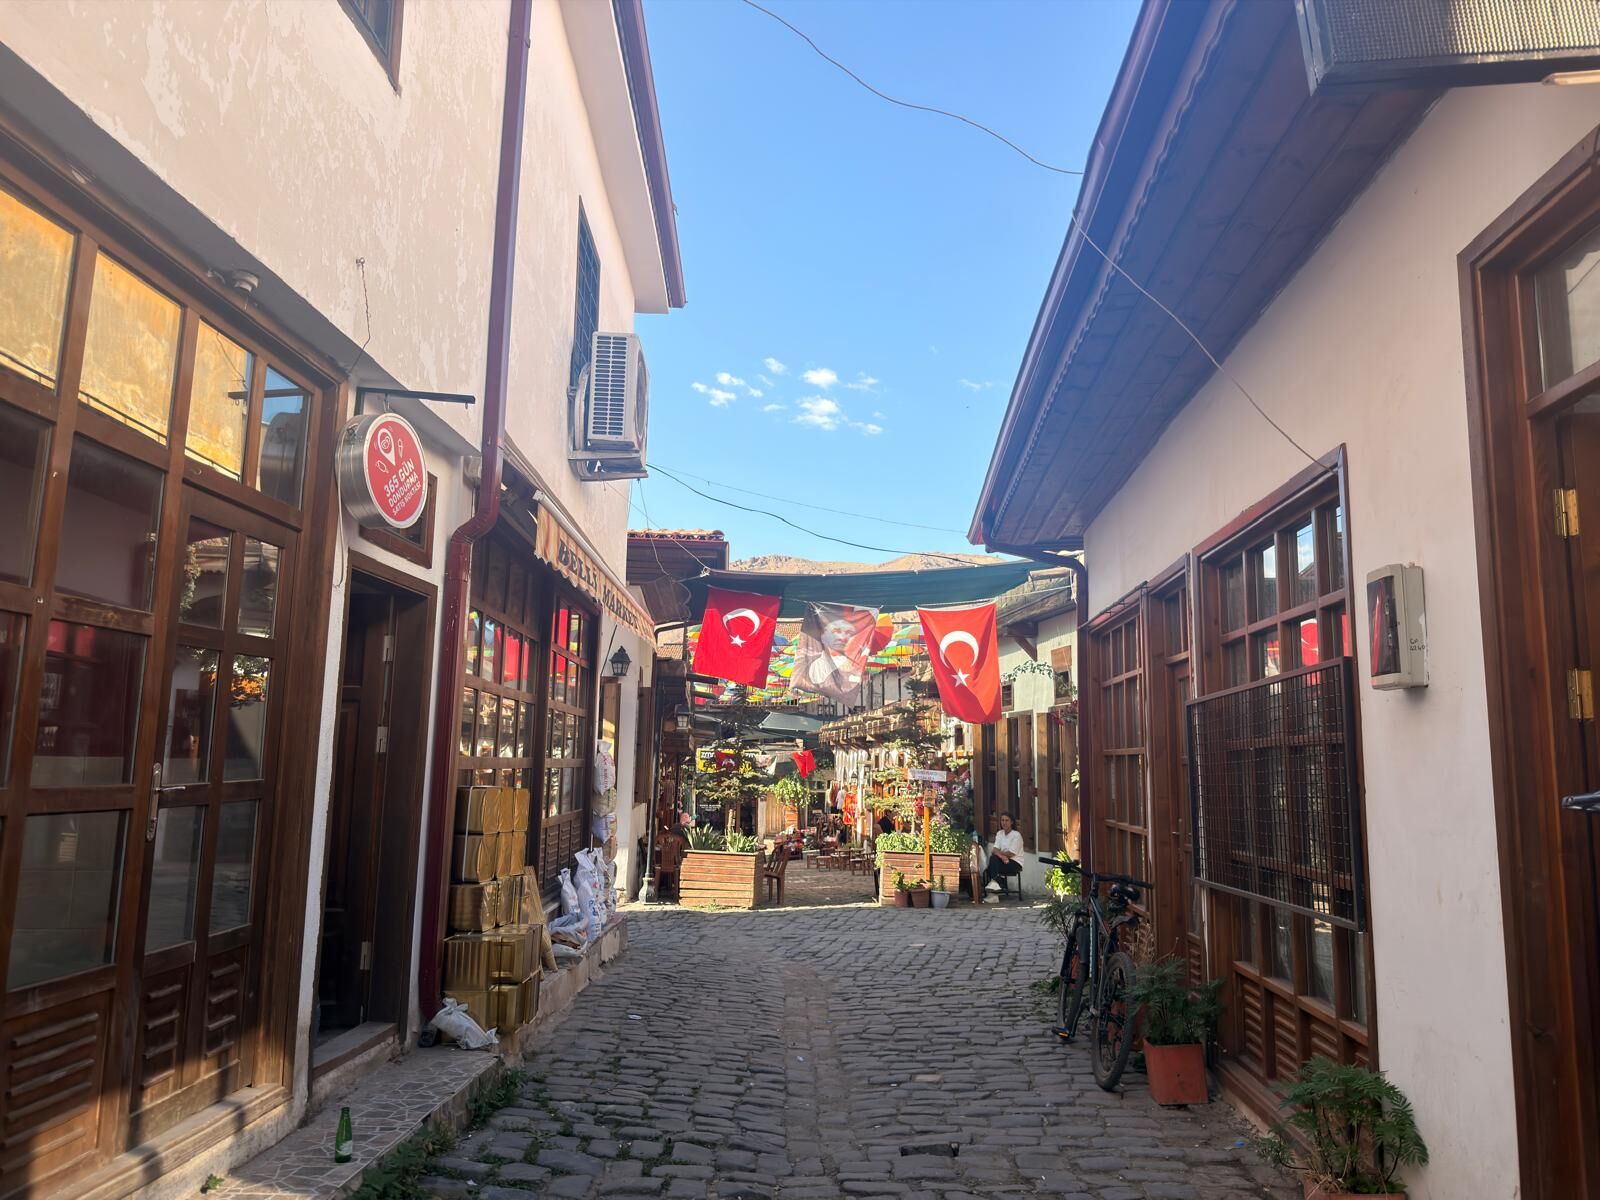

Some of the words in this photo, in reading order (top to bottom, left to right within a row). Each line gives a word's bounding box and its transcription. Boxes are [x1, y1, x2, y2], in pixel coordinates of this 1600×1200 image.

[383, 475, 399, 497] 365
[398, 458, 415, 482] GÜN
[388, 472, 418, 507] DONDURMA
[602, 584, 638, 629] MARKET
